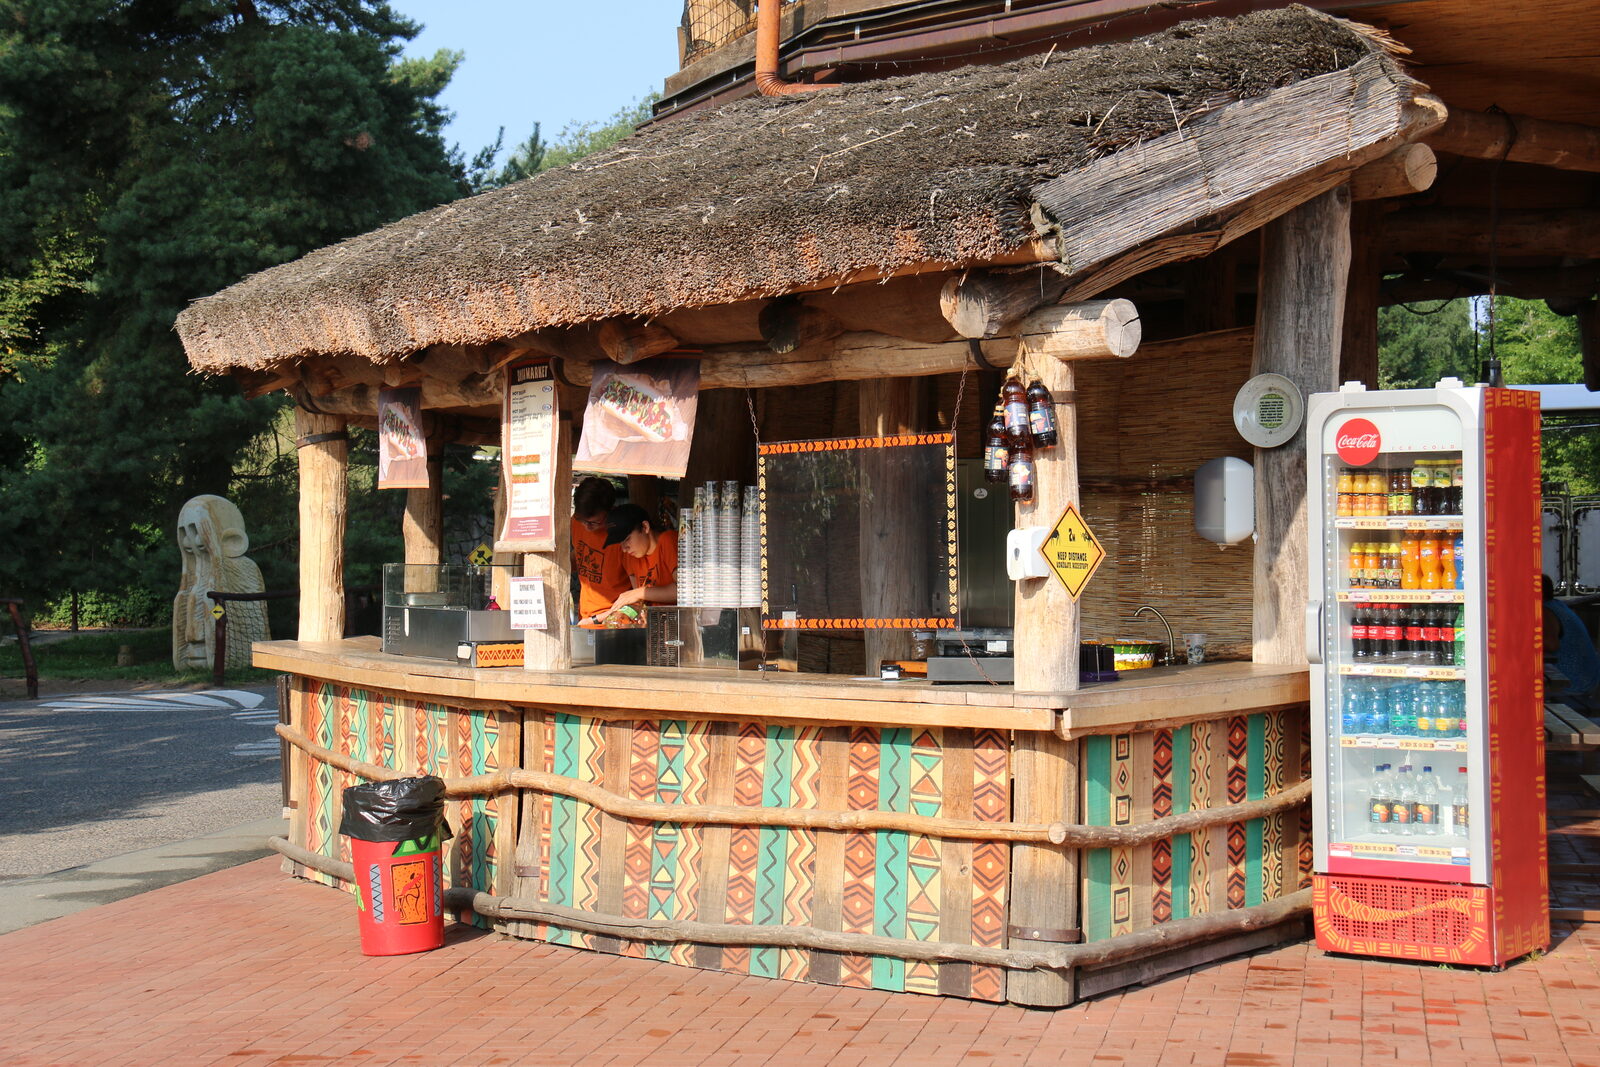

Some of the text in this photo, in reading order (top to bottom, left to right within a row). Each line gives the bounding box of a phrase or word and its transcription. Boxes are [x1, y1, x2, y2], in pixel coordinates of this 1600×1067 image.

[1338, 434, 1378, 448] Coca-Cola
[1058, 552, 1088, 561] KEEP DISTANCE
